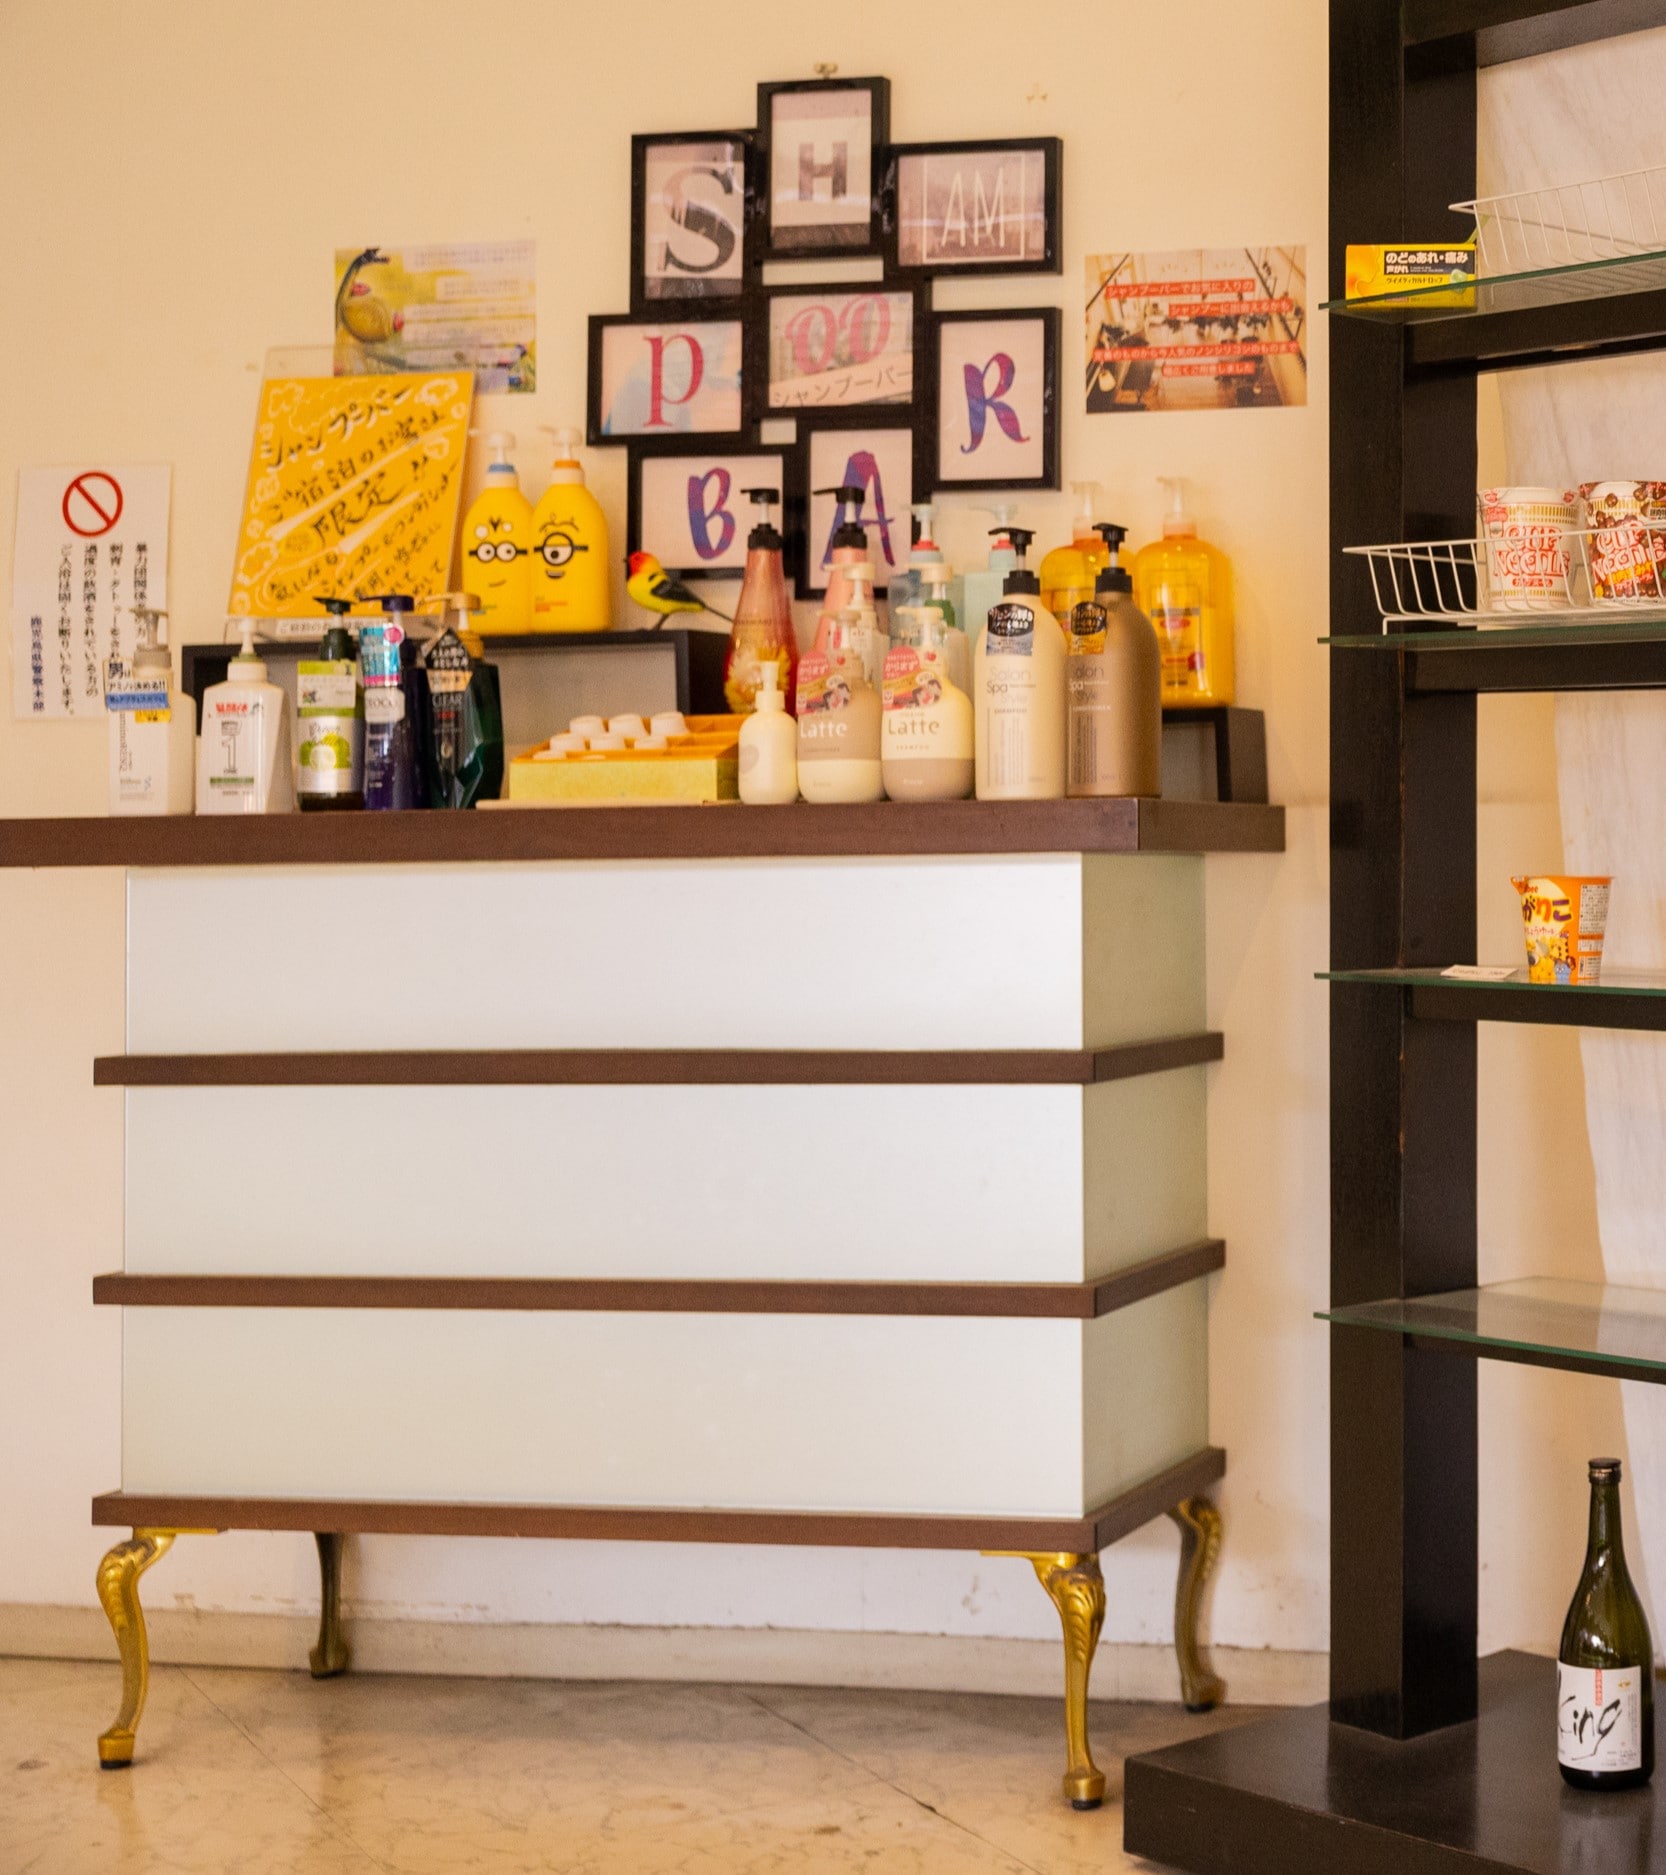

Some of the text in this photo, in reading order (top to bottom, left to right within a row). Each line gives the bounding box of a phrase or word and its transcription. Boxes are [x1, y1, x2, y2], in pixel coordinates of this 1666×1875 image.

[798, 140, 848, 200] H
[657, 165, 737, 273] S
[940, 170, 1006, 248] AM
[1385, 251, 1469, 264] のどのあれ・痛み
[960, 352, 1031, 454] R
[686, 467, 737, 561] B
[822, 449, 896, 569] A
[986, 680, 1009, 696] Spa
[800, 722, 848, 738] Latte
[888, 719, 940, 735] Latte
